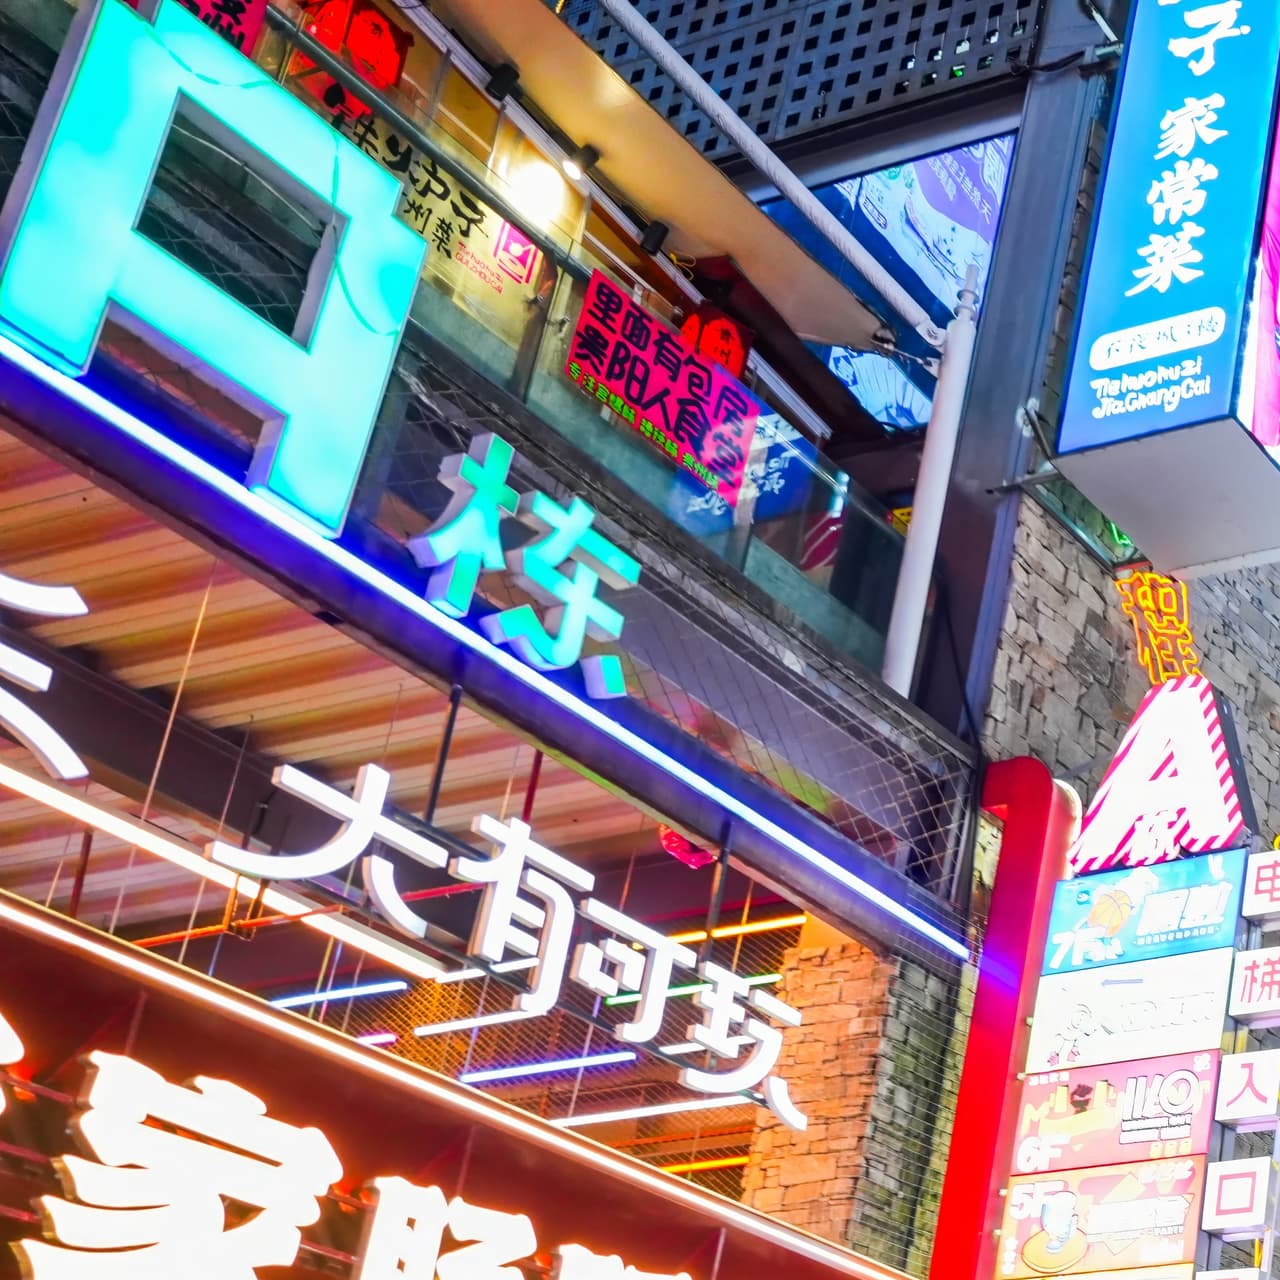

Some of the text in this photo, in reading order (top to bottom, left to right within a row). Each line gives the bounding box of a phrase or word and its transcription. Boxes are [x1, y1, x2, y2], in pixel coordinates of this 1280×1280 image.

[574, 324, 745, 489] 贵阳人食堂
